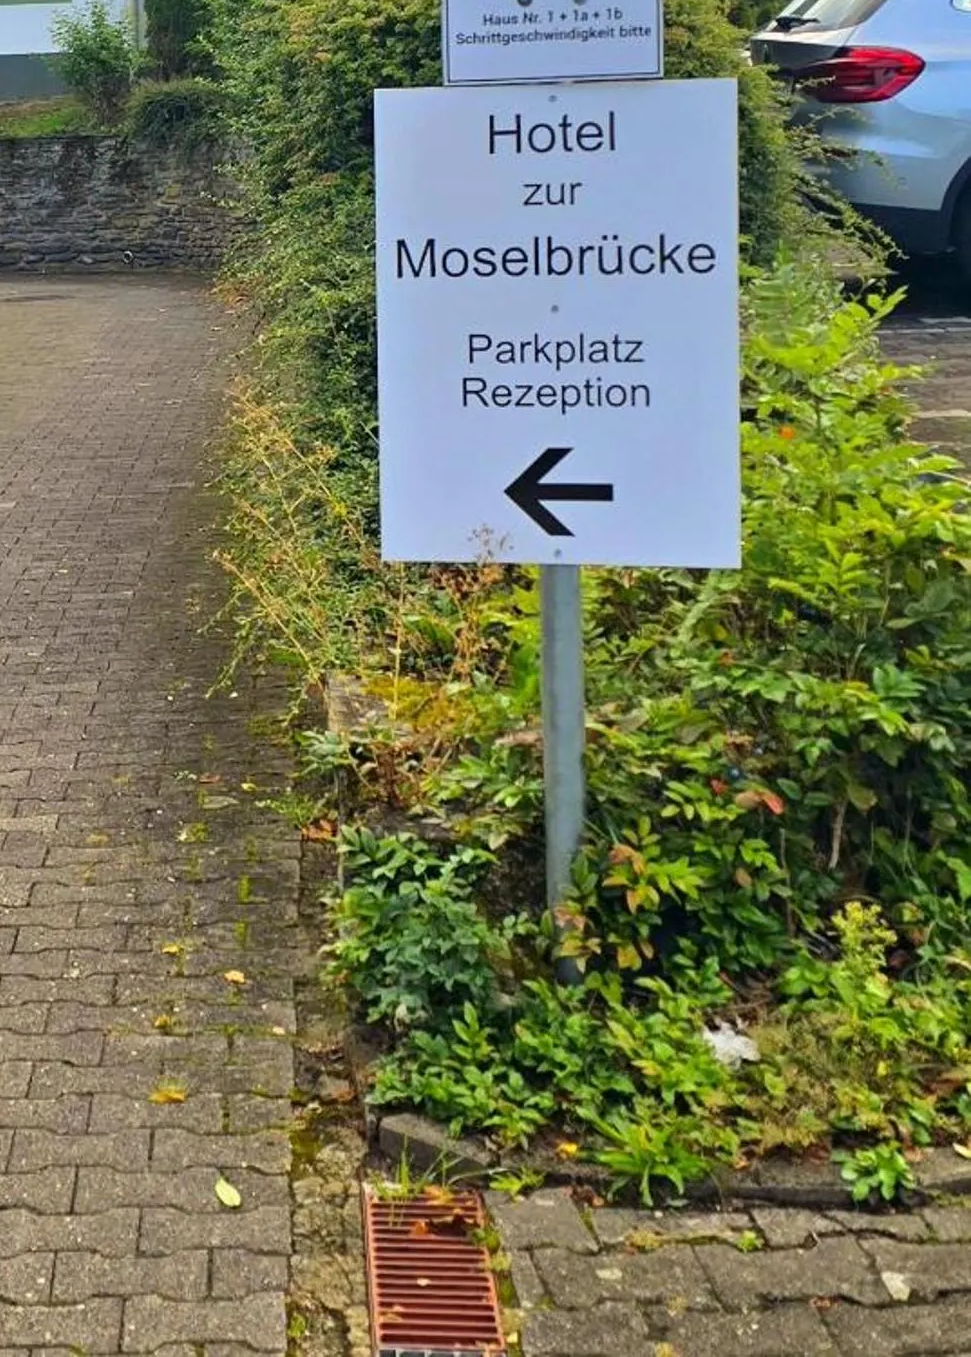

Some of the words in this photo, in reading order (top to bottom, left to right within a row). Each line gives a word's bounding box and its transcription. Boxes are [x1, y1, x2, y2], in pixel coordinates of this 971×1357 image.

[455, 25, 616, 47] Schrittgeschwindigkeit
[618, 24, 652, 39] bitte
[482, 11, 519, 27] Haus
[522, 11, 543, 25] Nr.
[547, 10, 554, 22] 1
[559, 12, 568, 22] +
[573, 9, 589, 22] 1a
[593, 10, 601, 19] +
[605, 7, 624, 21] 1b
[487, 110, 617, 155] Hotel
[521, 179, 584, 207] zur
[395, 234, 718, 279] Moselbrücke
[467, 333, 646, 372] Parkplatz
[461, 376, 651, 415] Rezeption
